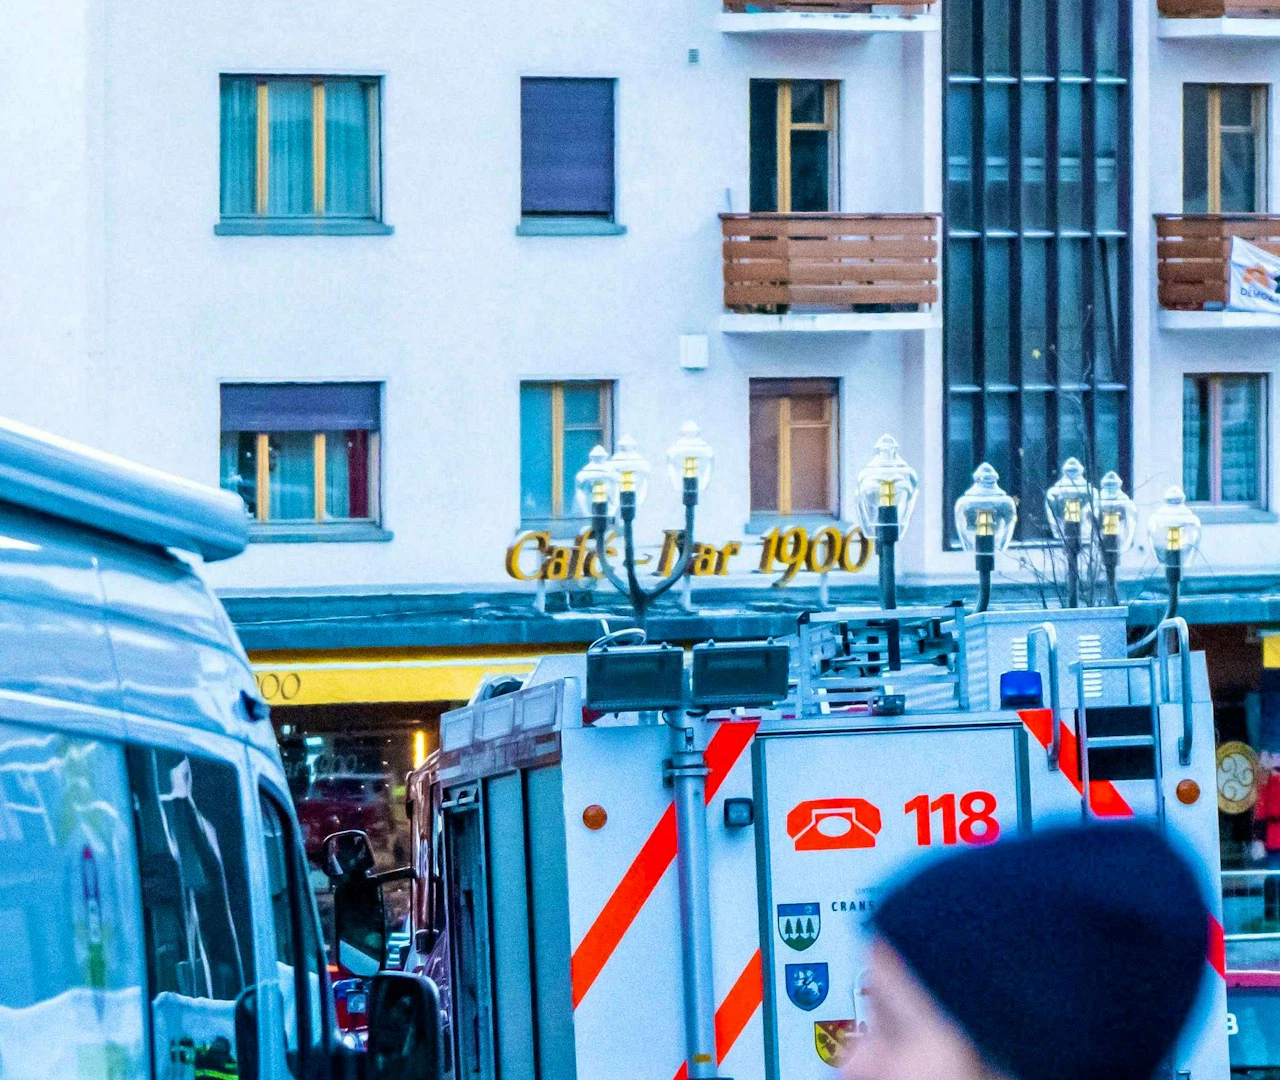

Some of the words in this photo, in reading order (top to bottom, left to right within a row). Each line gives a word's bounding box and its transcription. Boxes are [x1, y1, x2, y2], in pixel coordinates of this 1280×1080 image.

[505, 529, 618, 580] Café
[755, 526, 873, 588] 1900
[904, 789, 1001, 847] 118
